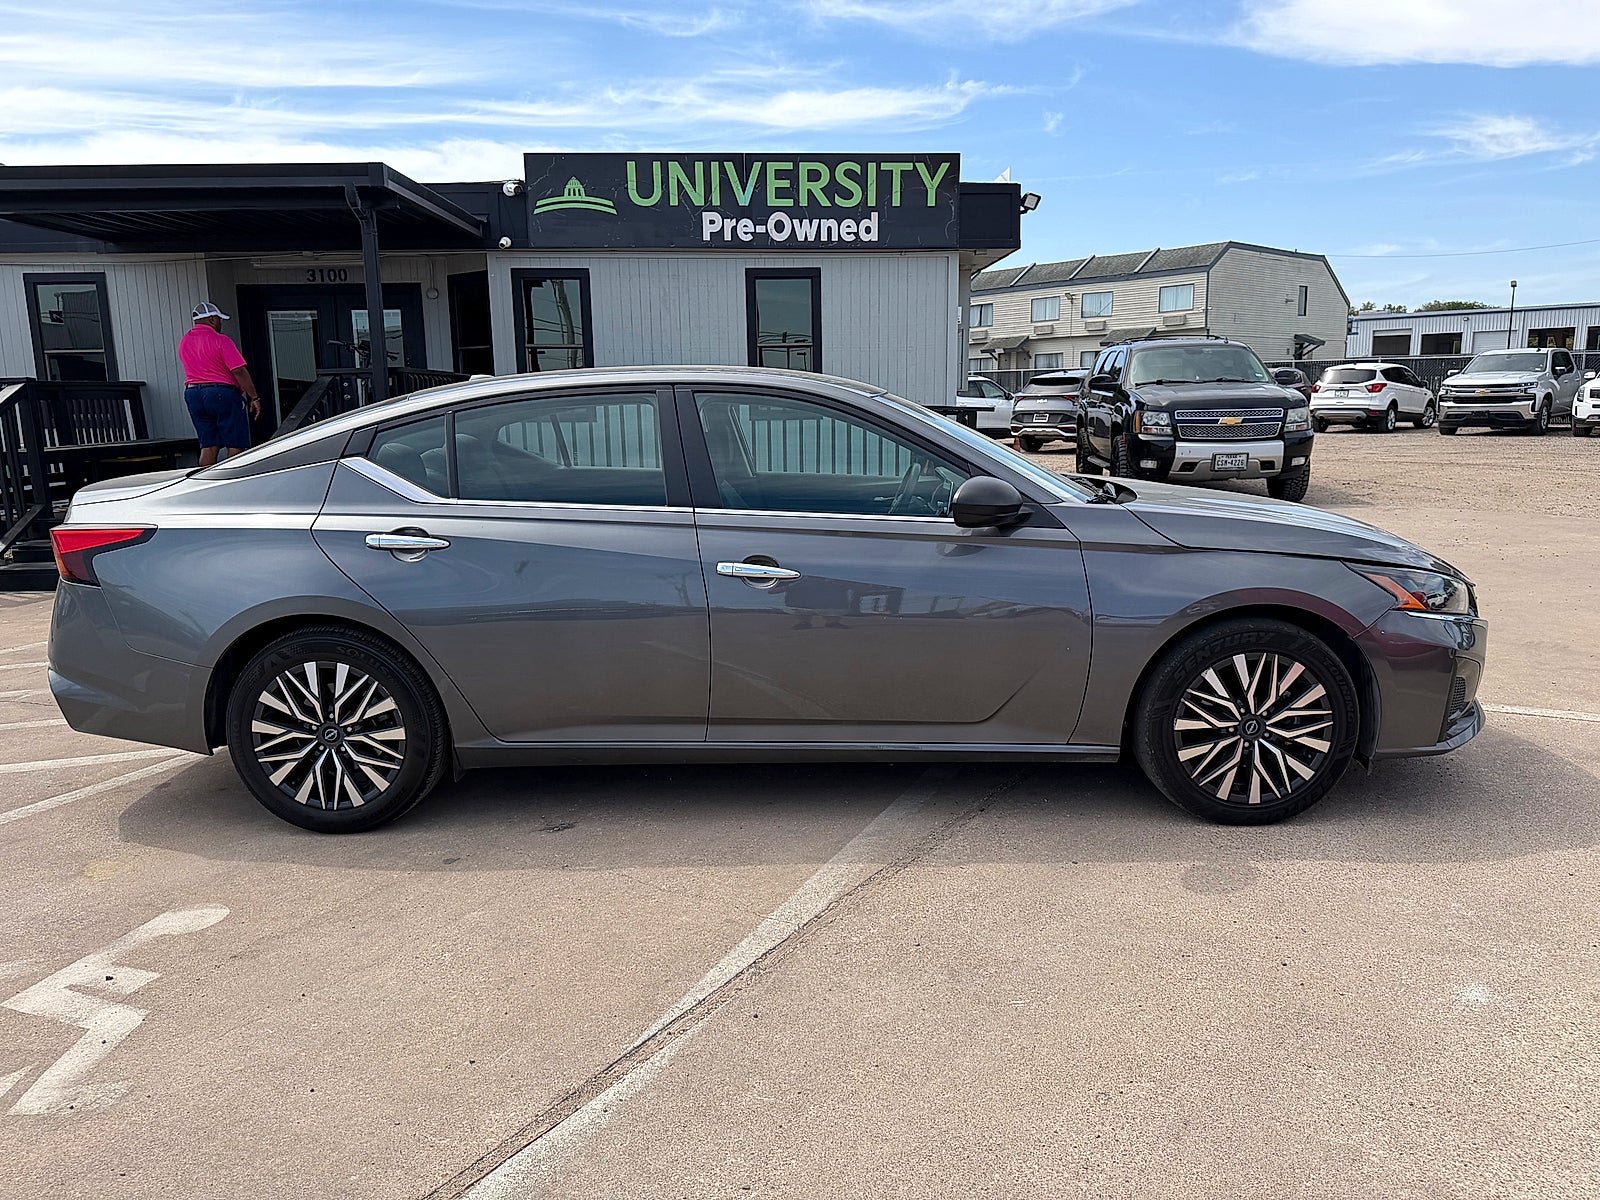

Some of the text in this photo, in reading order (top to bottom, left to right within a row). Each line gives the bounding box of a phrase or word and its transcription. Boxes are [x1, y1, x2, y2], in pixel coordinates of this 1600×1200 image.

[626, 160, 951, 207] UNIVERSITY
[702, 211, 879, 242] Pre-Owned
[306, 268, 348, 283] 3100
